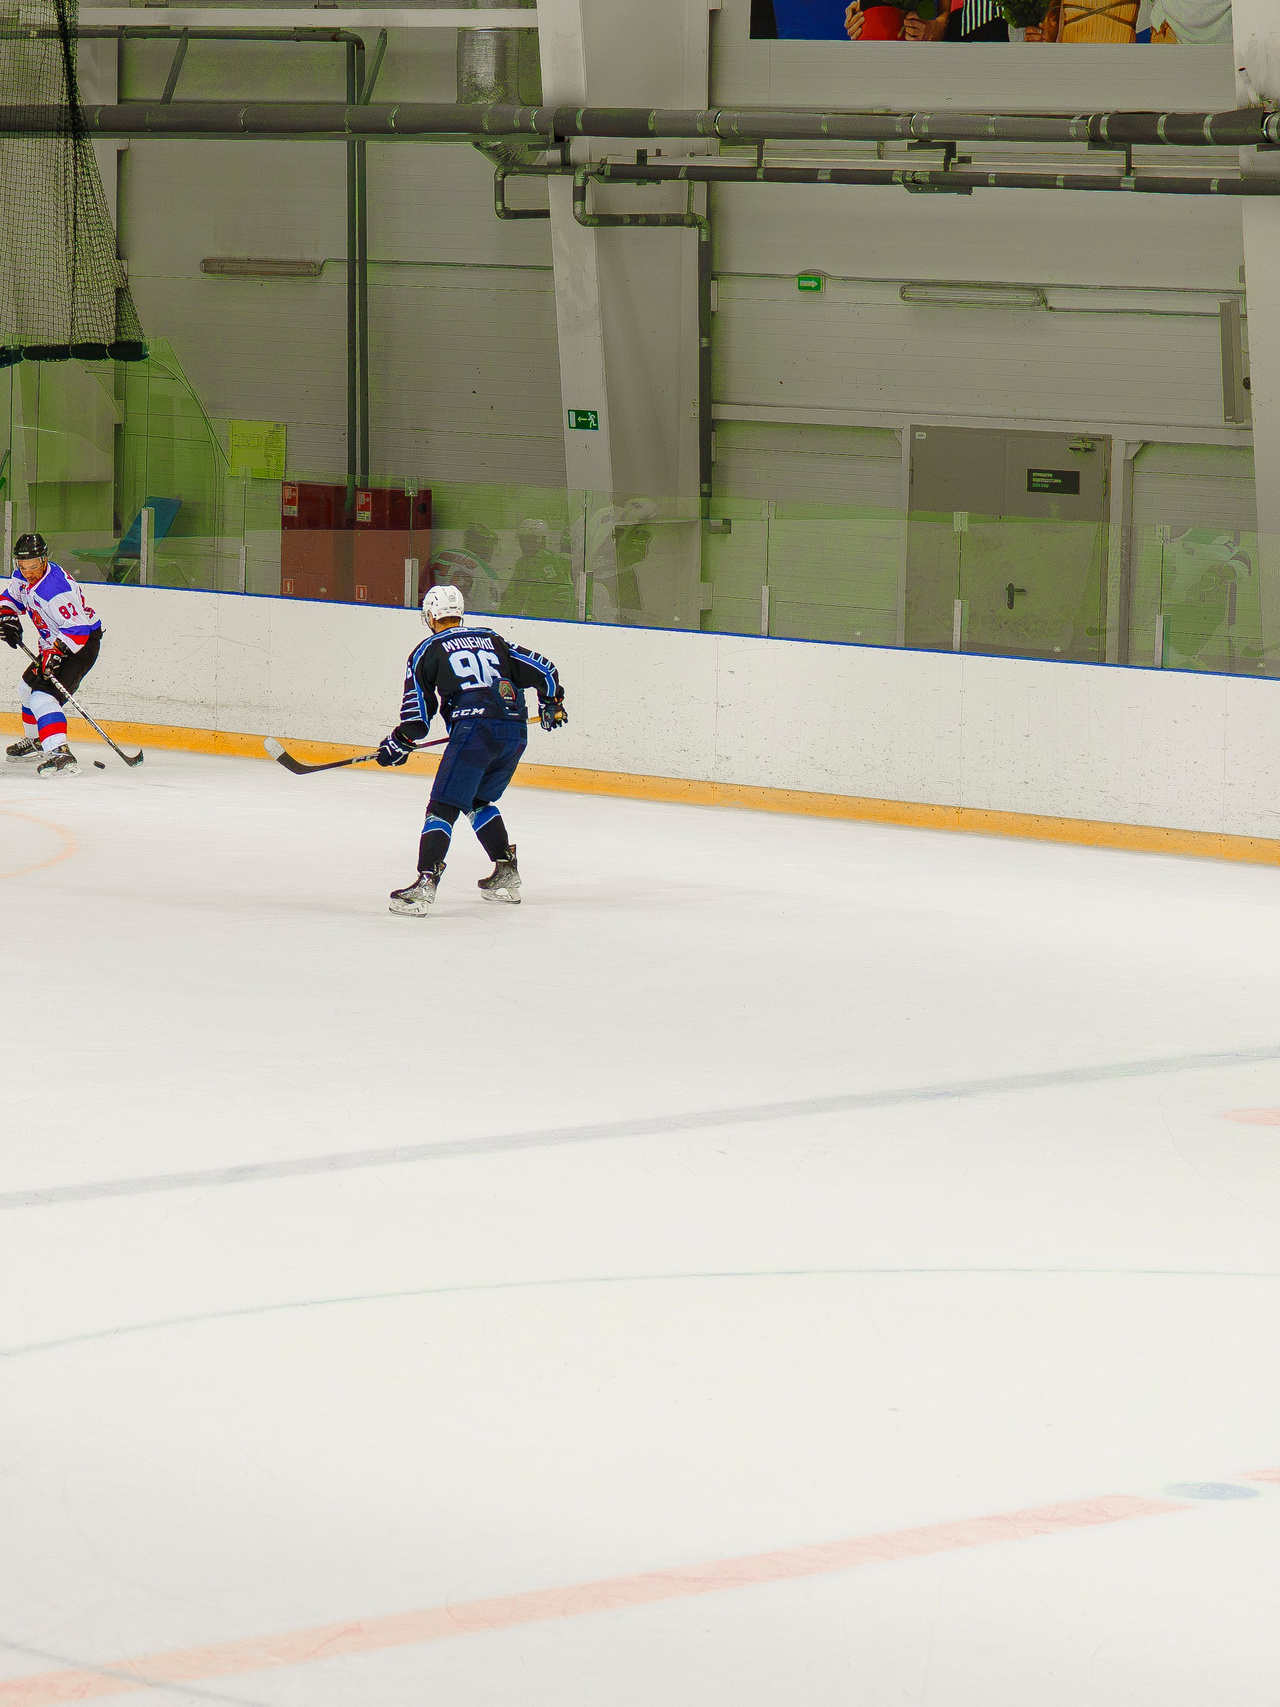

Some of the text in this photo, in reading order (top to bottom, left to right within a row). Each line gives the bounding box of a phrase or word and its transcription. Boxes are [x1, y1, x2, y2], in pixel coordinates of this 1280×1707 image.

[58, 602, 79, 620] 87
[448, 649, 503, 691] 96
[451, 707, 486, 719] CCM
